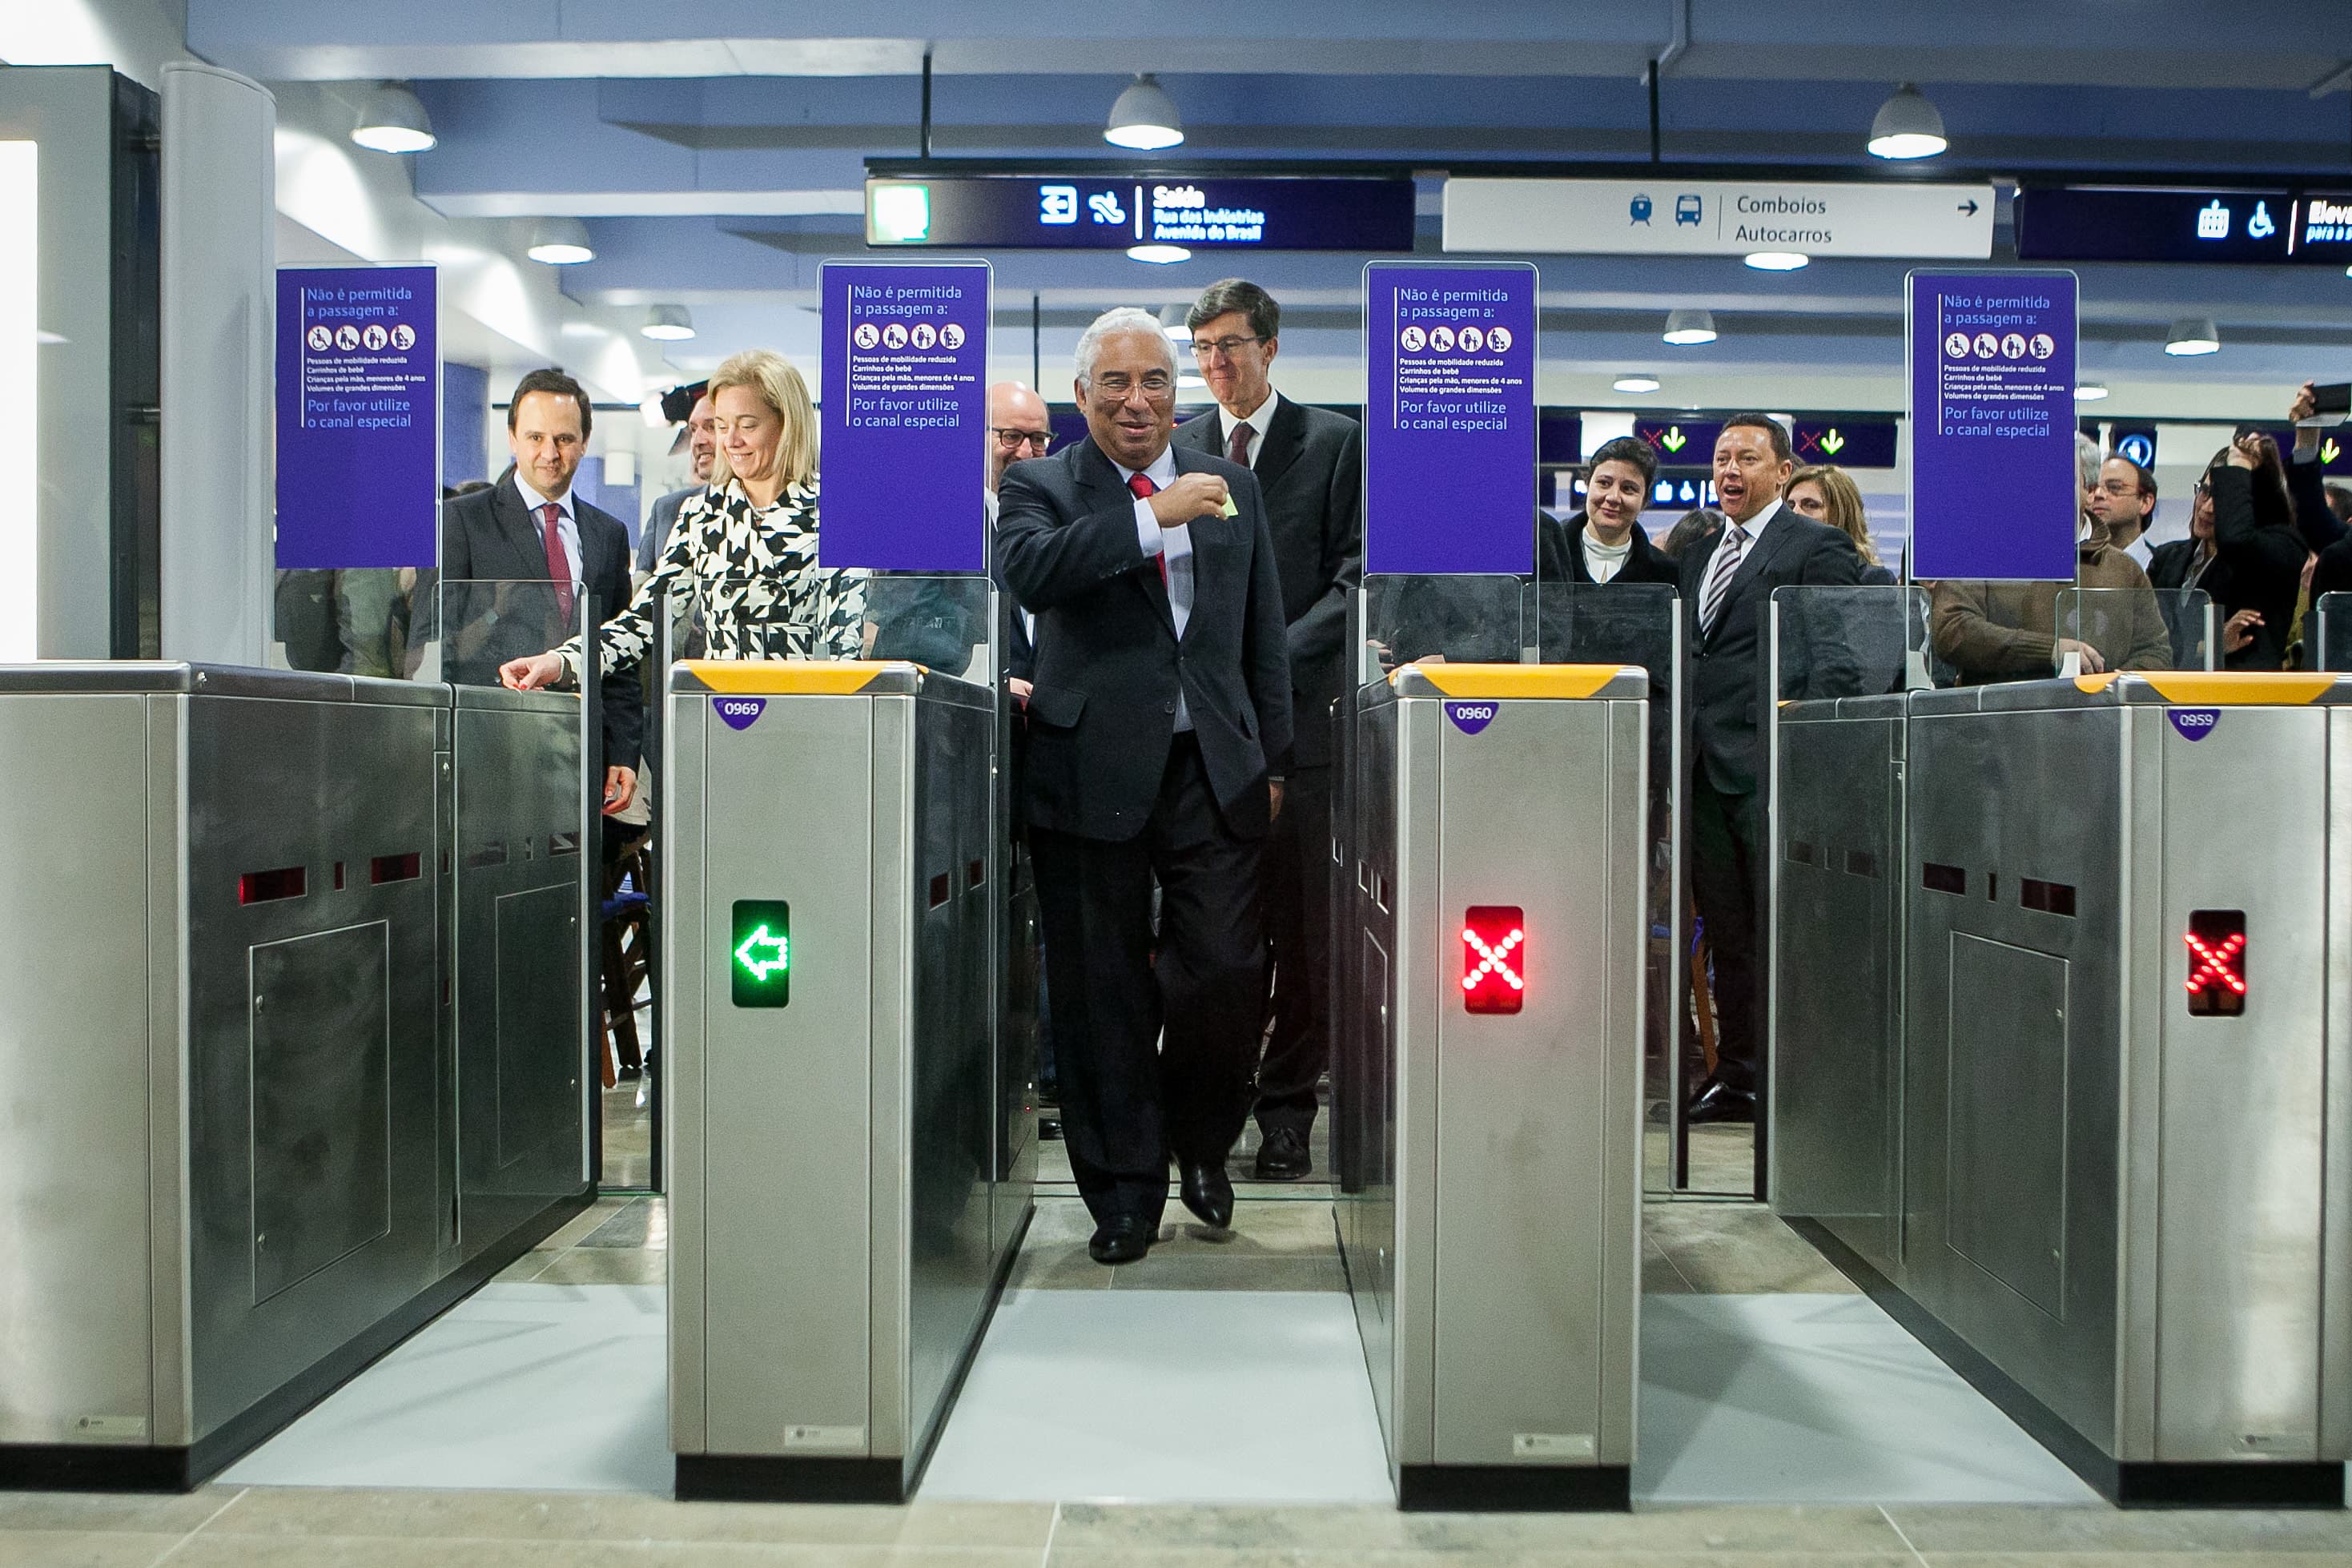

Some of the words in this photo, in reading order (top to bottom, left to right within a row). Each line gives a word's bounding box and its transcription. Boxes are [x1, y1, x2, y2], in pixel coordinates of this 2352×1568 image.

[1738, 196, 1826, 214] Comboios
[1736, 224, 1831, 243] Autocarros
[308, 288, 333, 301] Não
[338, 288, 344, 300] é
[349, 287, 412, 303] permitida
[854, 286, 881, 298] Não
[886, 286, 893, 298] é
[898, 286, 961, 301] permitida
[1401, 288, 1427, 301] Não
[1432, 289, 1439, 301] é
[1444, 289, 1508, 304] permitida
[1945, 295, 1970, 308] Não
[1975, 296, 1983, 308] é
[1987, 296, 2049, 311] permitida
[308, 308, 314, 316] a
[319, 307, 384, 320] passagem
[388, 307, 399, 316] a:
[854, 305, 862, 314] a
[866, 305, 933, 317] passagem
[937, 305, 948, 314] a:
[1401, 308, 1407, 317] a
[1413, 308, 1479, 320] passagem
[1484, 308, 1494, 318] a:
[1944, 315, 1951, 324] a
[1956, 314, 2021, 328] passagem
[2026, 316, 2036, 324] a:
[882, 374, 895, 382] pela
[892, 384, 918, 392] grandes
[1439, 387, 1465, 395] grandes
[854, 398, 875, 411] Por
[880, 397, 914, 410] favor
[918, 398, 959, 411] utilize
[1983, 393, 2008, 401] grandes
[308, 400, 329, 412] Por
[333, 399, 369, 411] favor
[371, 399, 410, 411] utilize
[1401, 400, 1423, 412] Por
[1427, 400, 1461, 413] favor
[1465, 400, 1506, 414] utilize
[1945, 407, 1967, 419] Por
[1972, 407, 2005, 420] favor
[2008, 407, 2048, 420] utilize
[308, 420, 316, 428] o
[320, 416, 353, 427] canal
[358, 414, 411, 430] especial
[853, 418, 862, 427] o
[866, 414, 899, 427] canal
[904, 414, 959, 430] especial
[1401, 420, 1409, 429] o
[1413, 416, 1448, 429] canal
[1452, 416, 1506, 432] especial
[1945, 427, 1953, 436] o
[1957, 424, 1991, 436] canal
[1996, 424, 2049, 439] especial
[725, 703, 758, 715] 0969
[1457, 707, 1492, 719] 0960
[2180, 714, 2213, 726] 0959
